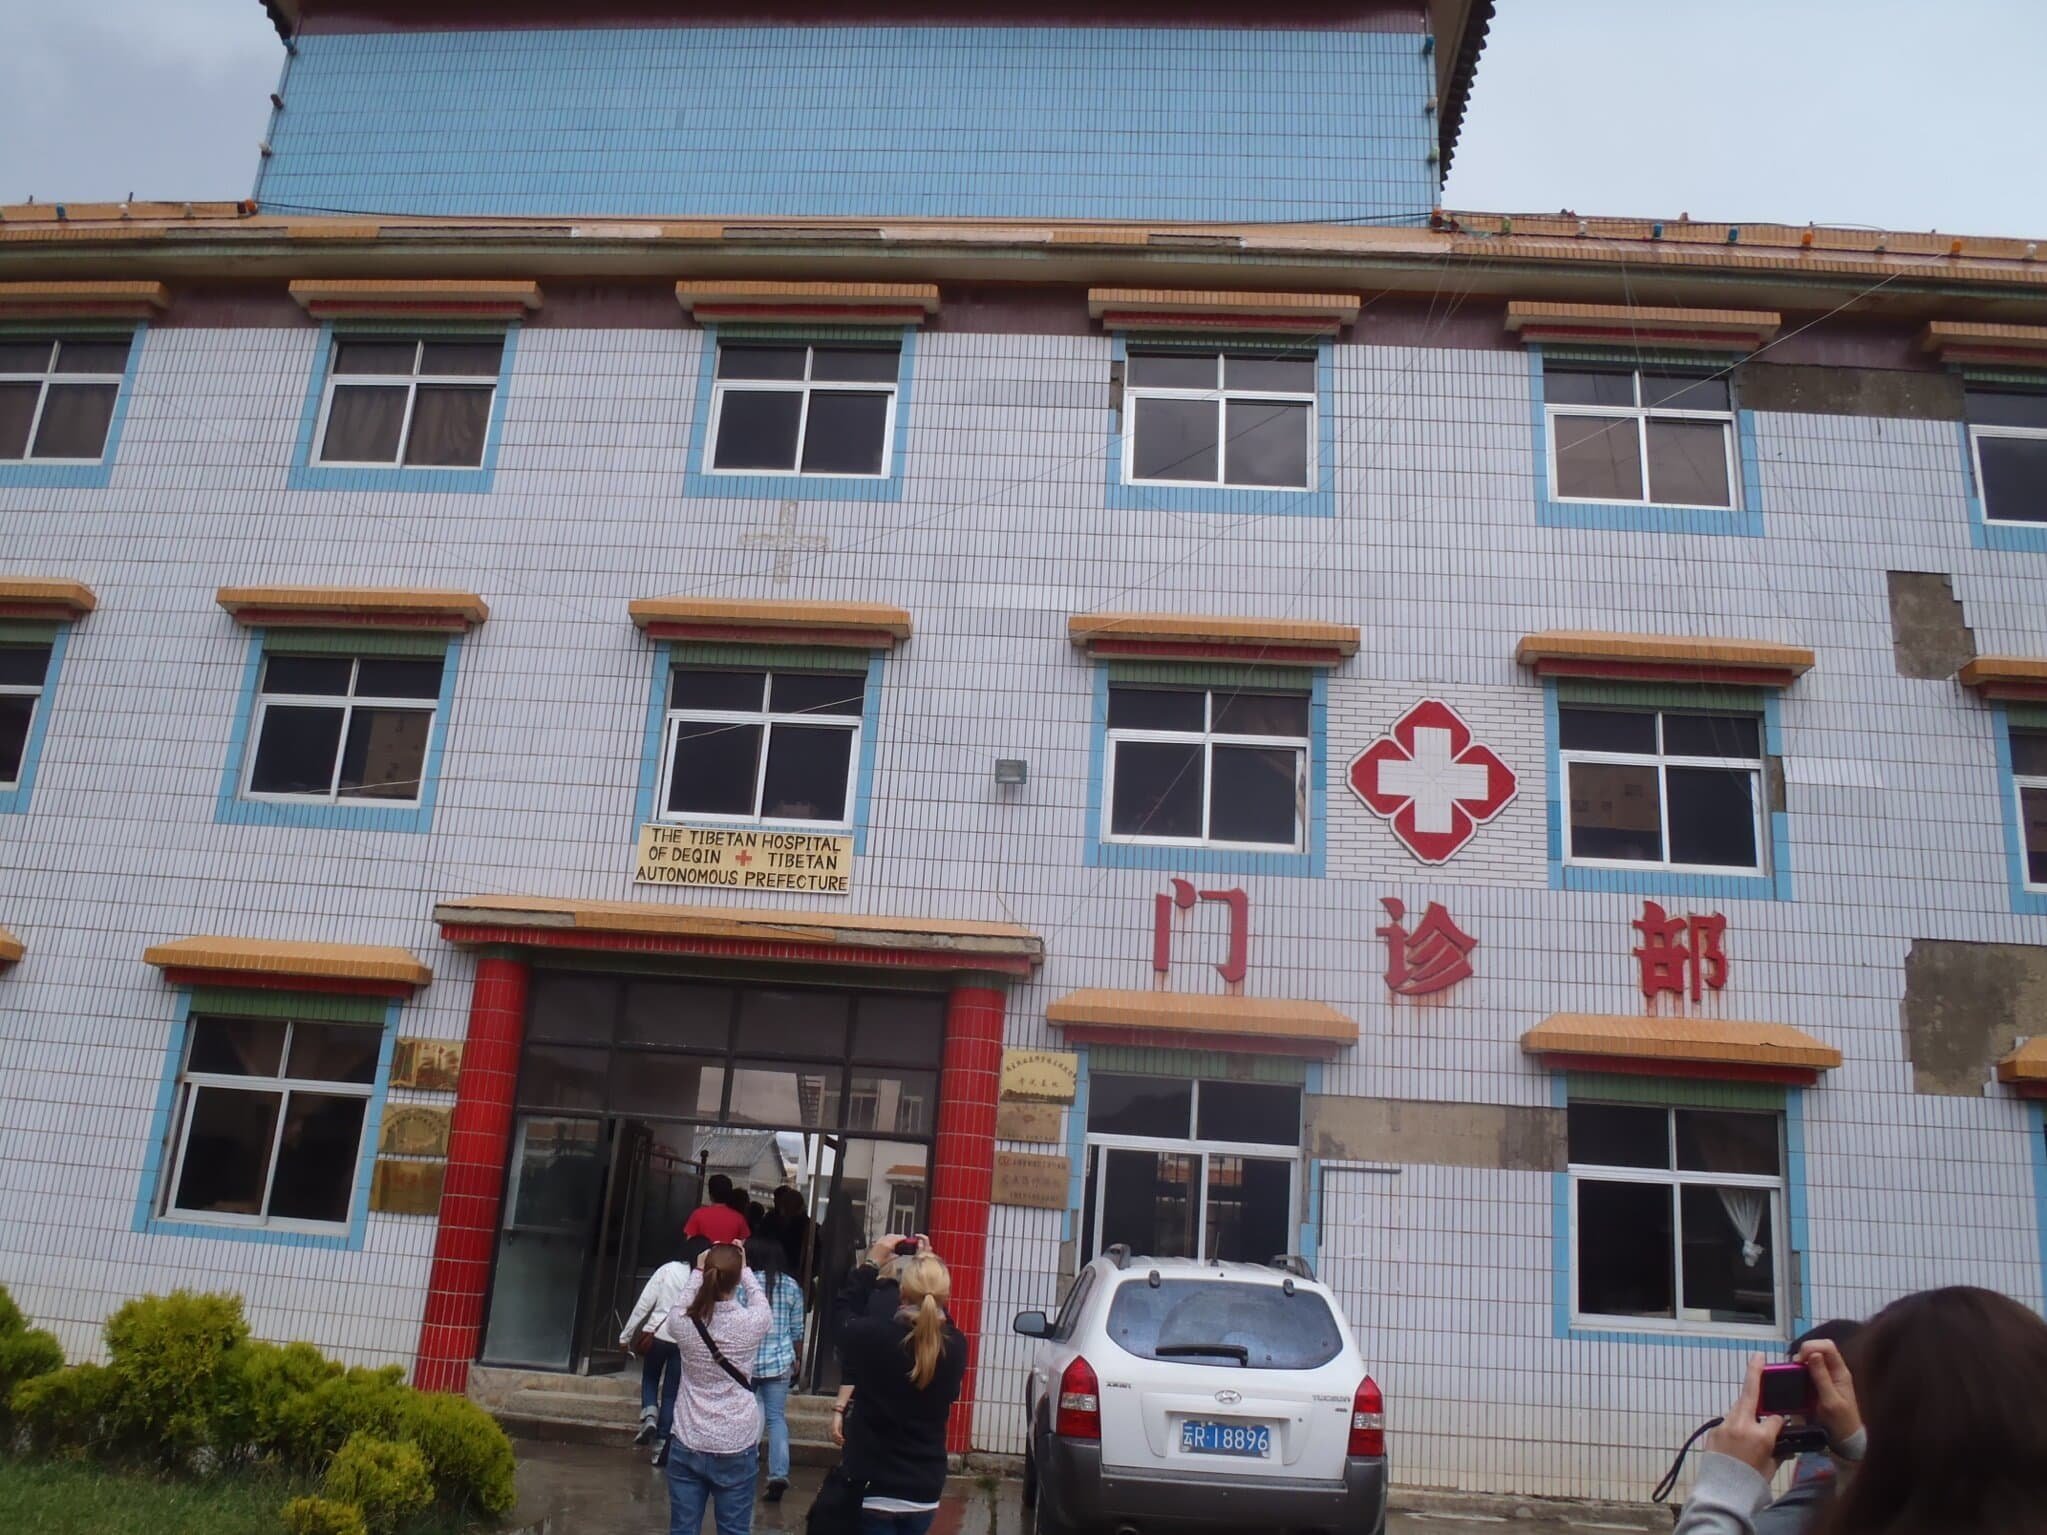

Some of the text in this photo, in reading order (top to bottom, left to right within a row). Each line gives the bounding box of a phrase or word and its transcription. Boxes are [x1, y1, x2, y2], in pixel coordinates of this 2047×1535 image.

[651, 828, 841, 852] THE TIBETAN HOSPITAL
[648, 846, 838, 870] OF DEQIN TIBETAN
[636, 866, 849, 892] AUTONOMOUS PREFECTURE
[1153, 877, 1727, 1001] 门诊部
